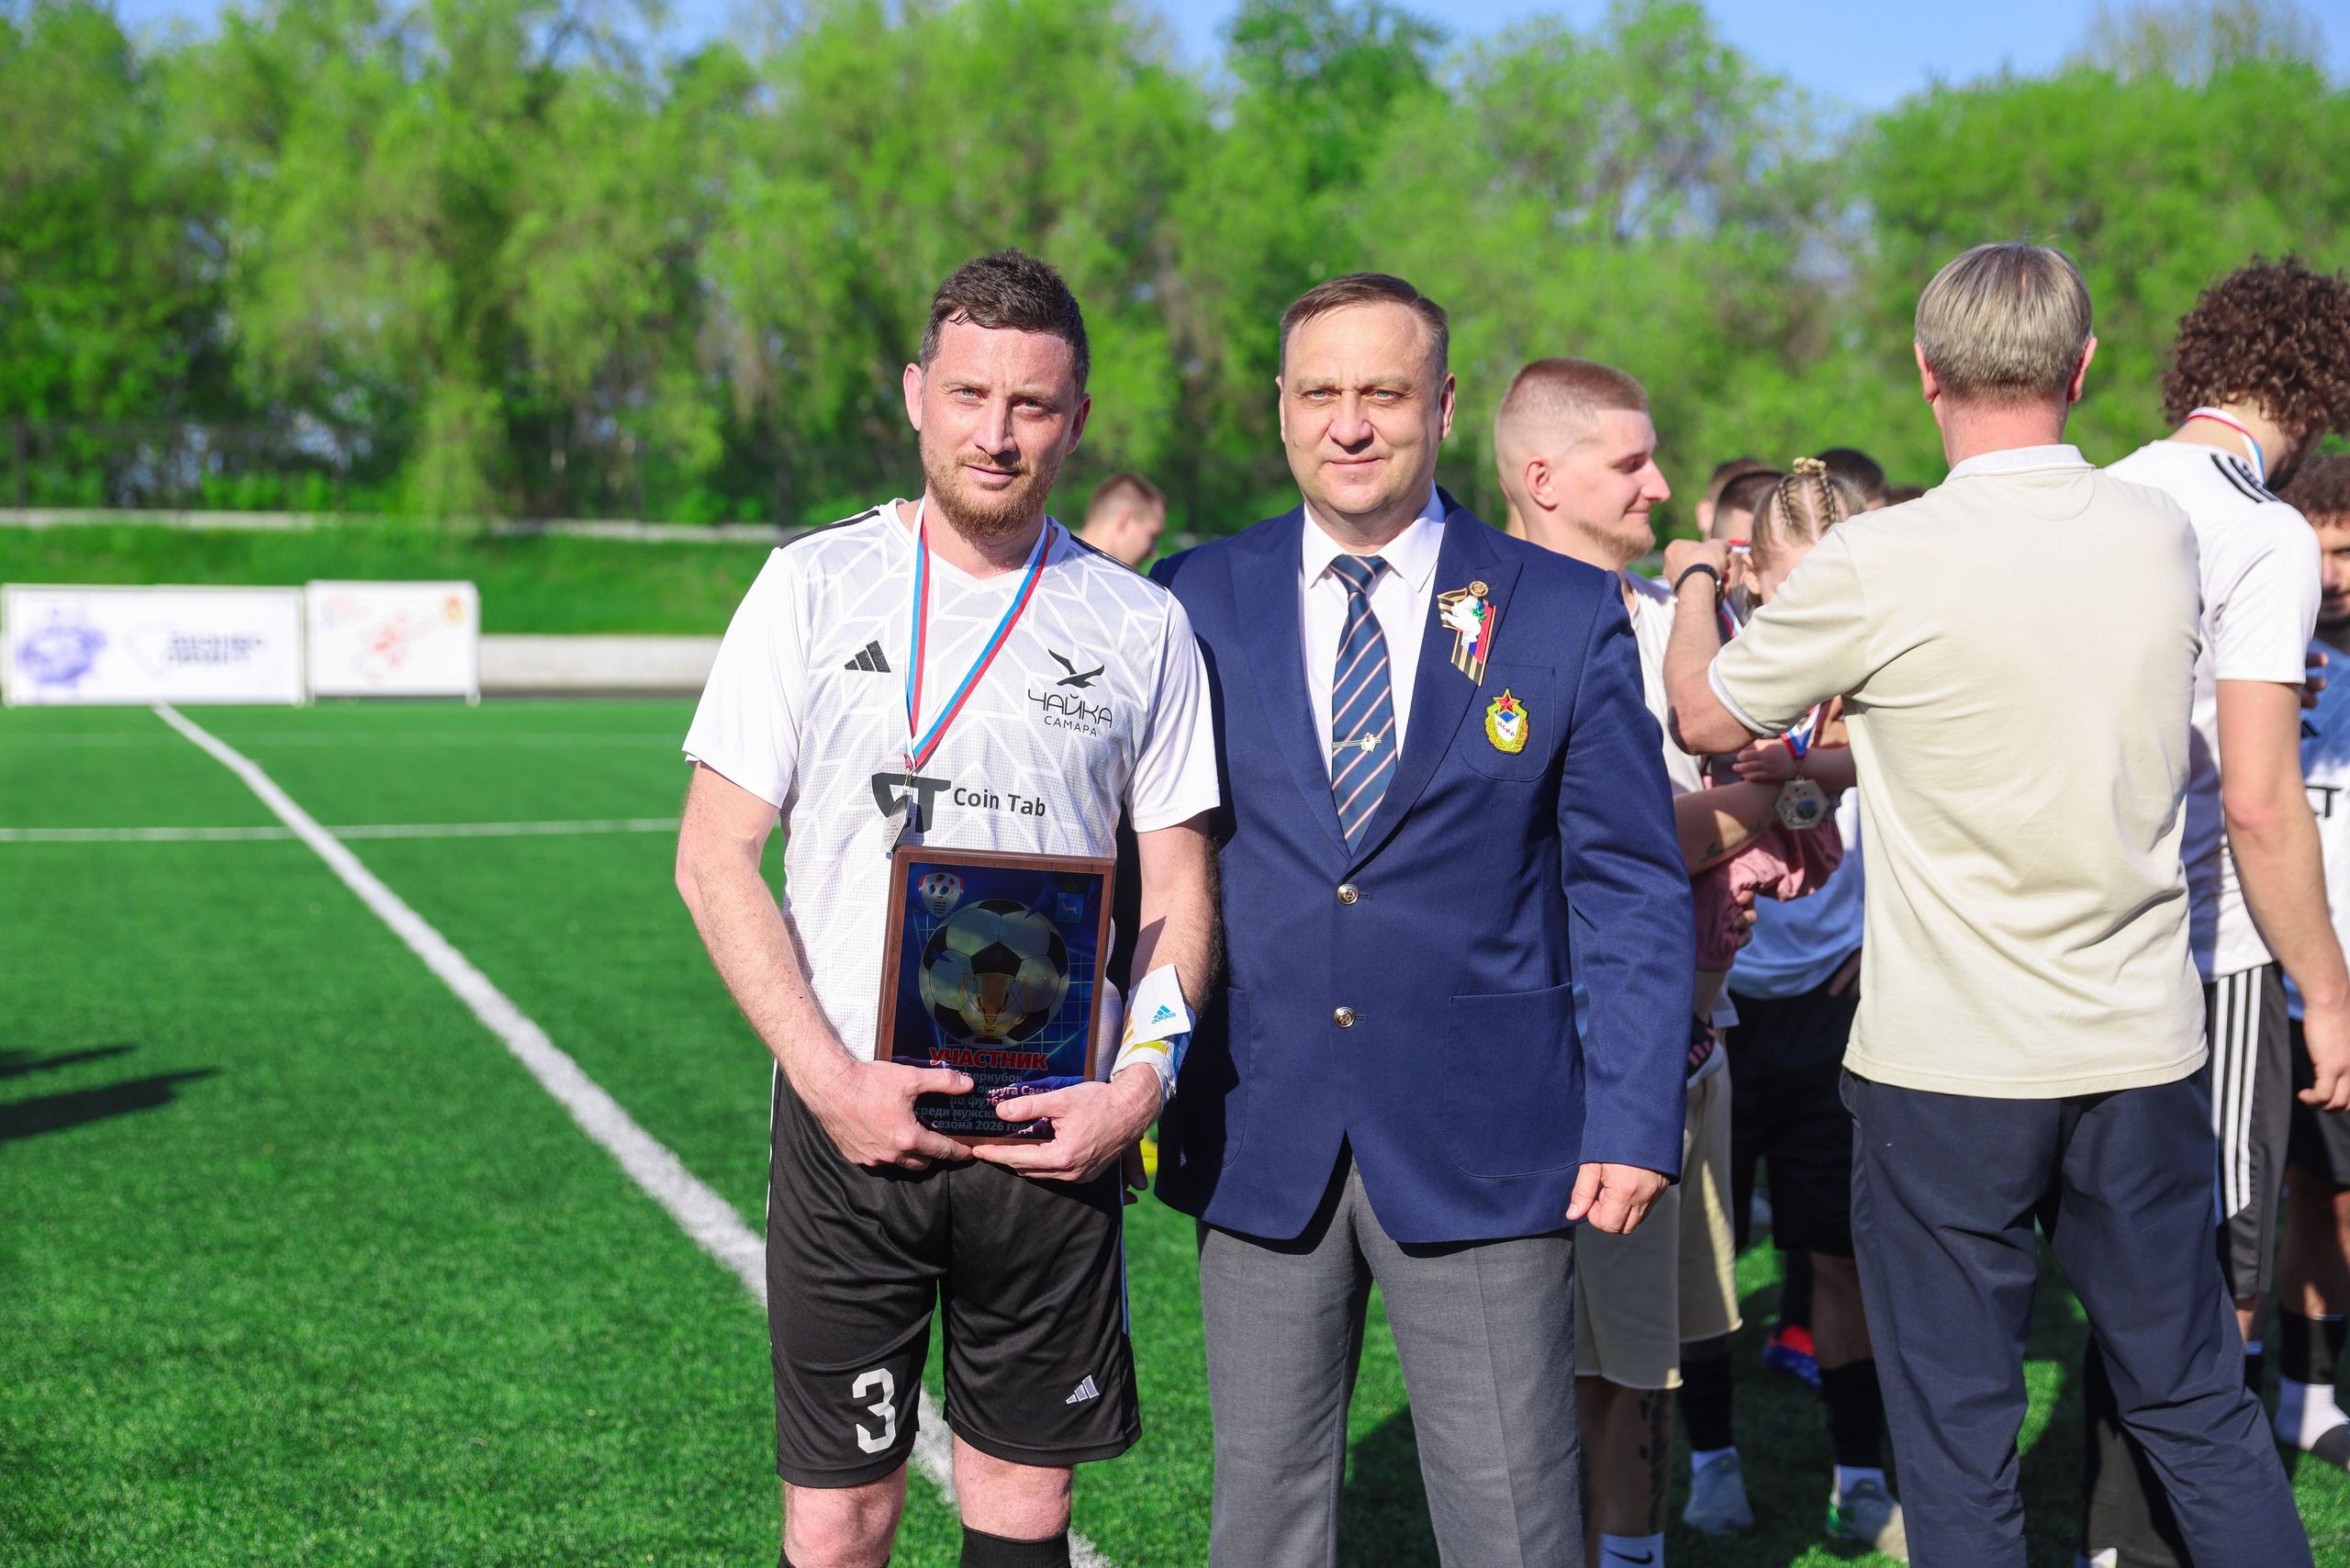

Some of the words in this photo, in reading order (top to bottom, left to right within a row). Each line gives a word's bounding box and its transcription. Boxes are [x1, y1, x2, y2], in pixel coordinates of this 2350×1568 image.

[1028, 689, 1113, 728] ЧАЙКА
[1044, 715, 1097, 737] САМАРА
[954, 787, 1000, 810] Coin
[1008, 793, 1046, 817] Tab
[1151, 1013, 1176, 1024] adidas
[929, 1047, 1048, 1070] УЧАСТНИК
[958, 1071, 1024, 1084] еркубок
[949, 1095, 965, 1105] по
[930, 1120, 973, 1131] сезона
[975, 1121, 1004, 1132] 2026
[852, 1368, 897, 1454] 3
